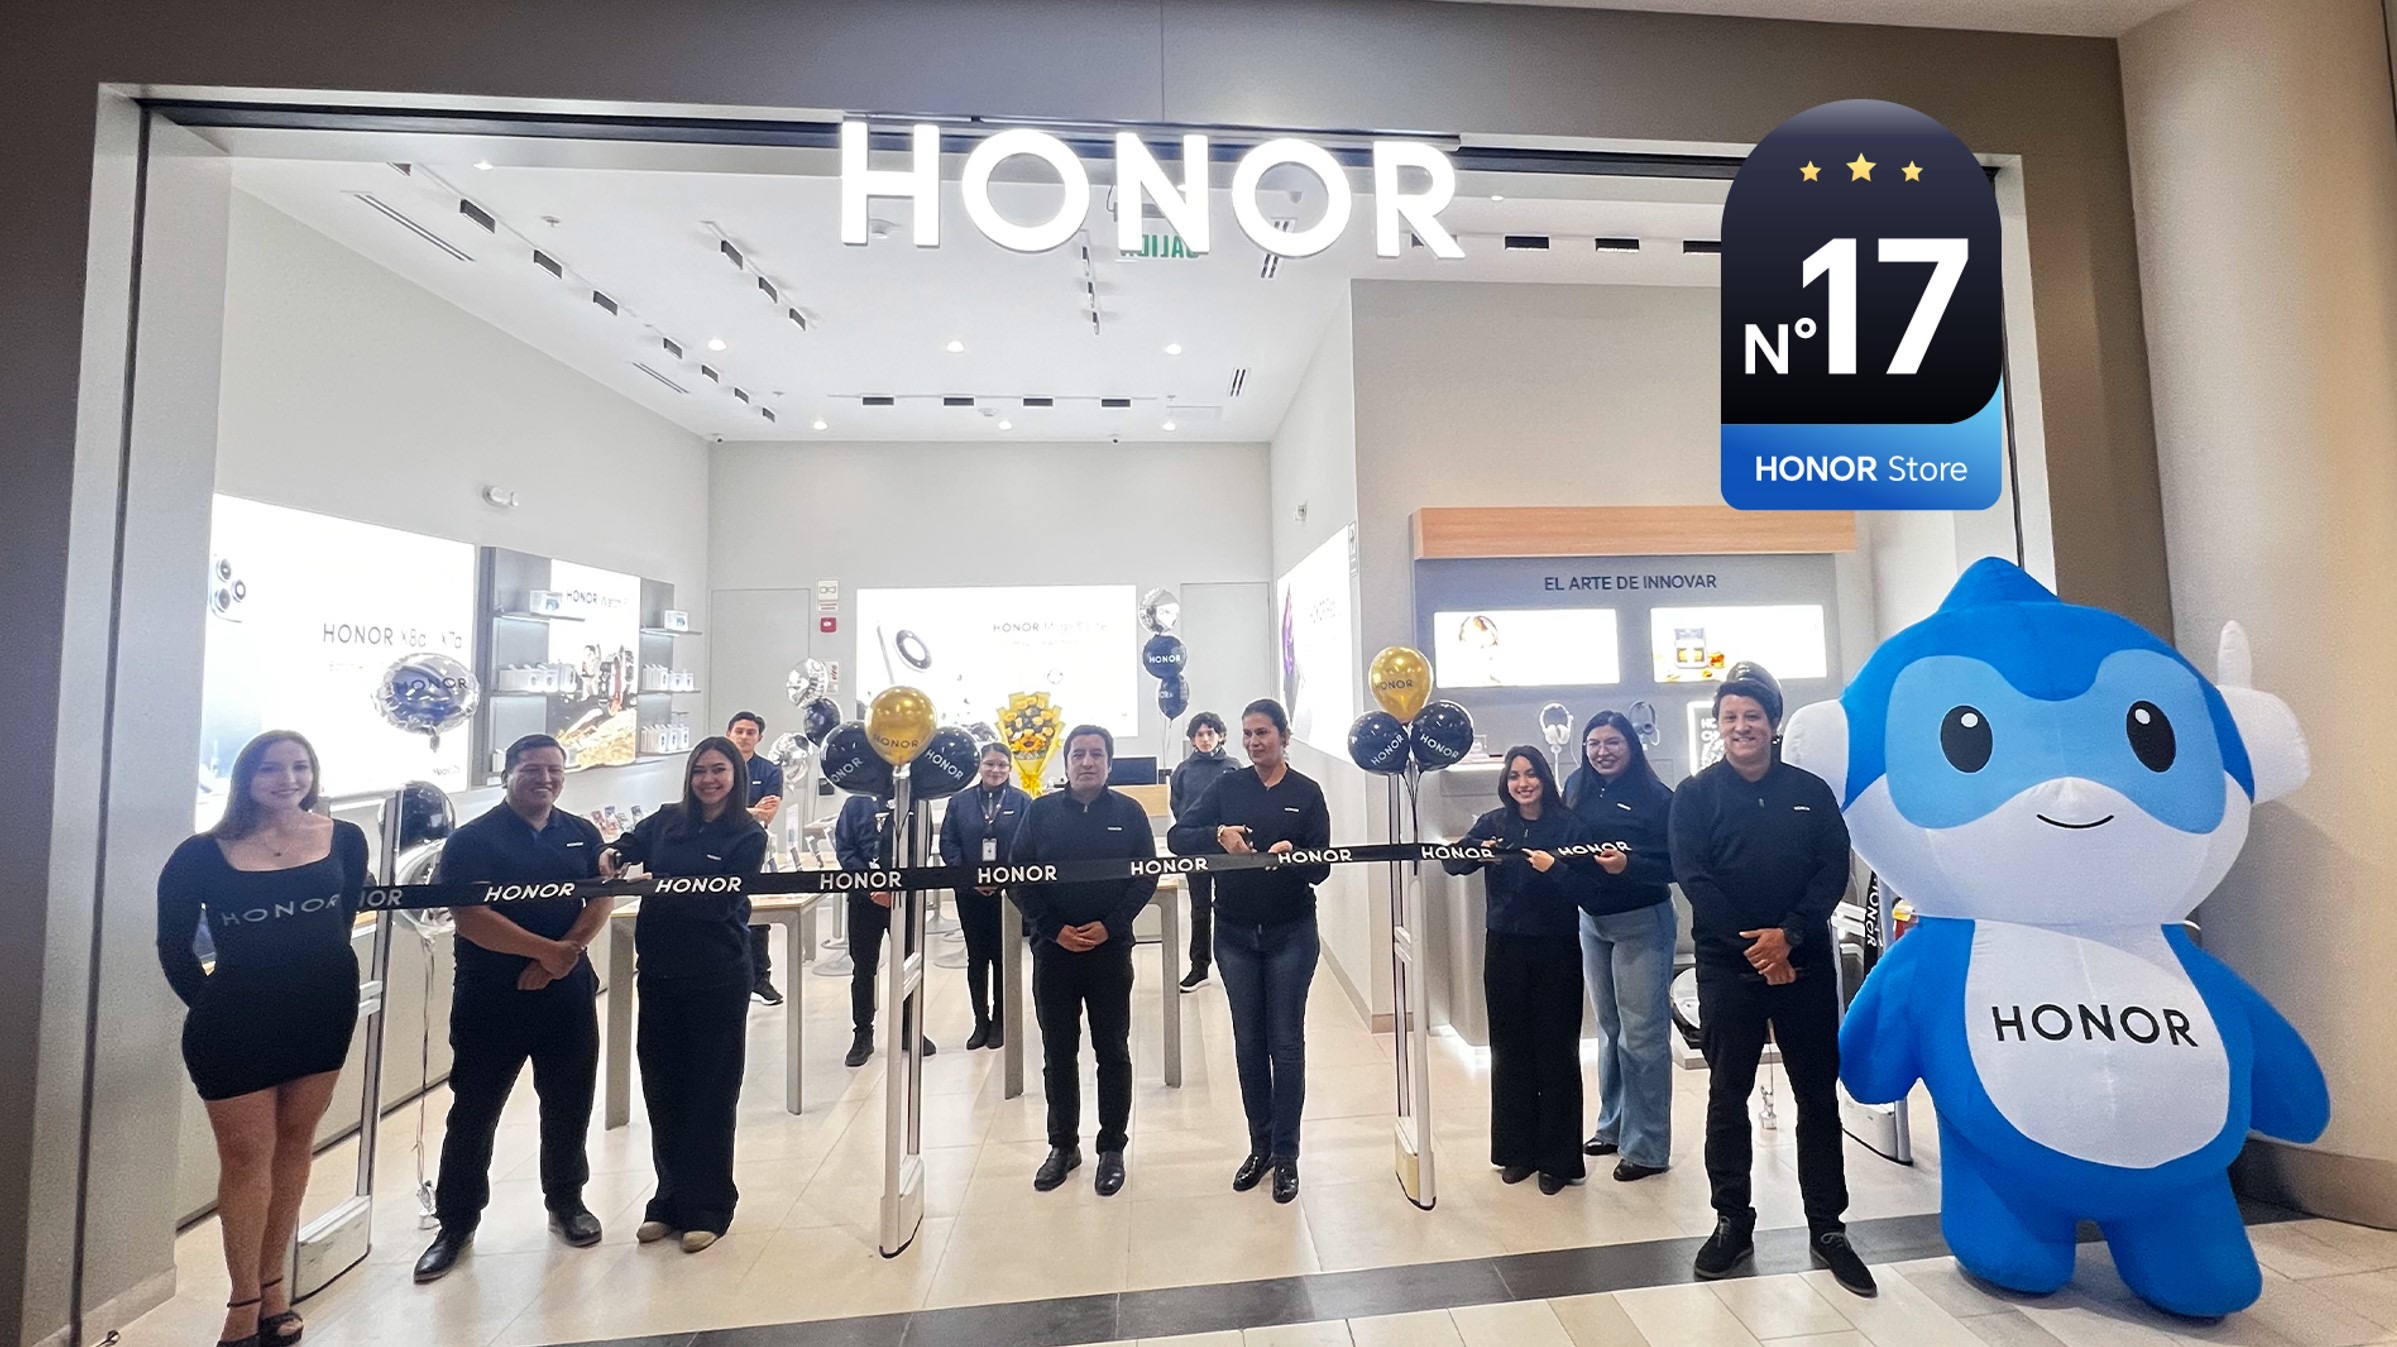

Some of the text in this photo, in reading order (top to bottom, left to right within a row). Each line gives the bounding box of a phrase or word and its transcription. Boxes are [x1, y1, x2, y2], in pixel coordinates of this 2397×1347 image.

[841, 121, 1465, 259] HONOR
[1544, 574, 1717, 591] EL ARTE DE INNOVAR
[566, 590, 598, 605] HONOR
[323, 623, 394, 646] HONOR
[993, 622, 1039, 632] HONOR
[1148, 654, 1181, 664] HONOR
[1374, 679, 1413, 691] HONOR
[873, 734, 919, 749] HONOR
[1371, 733, 1405, 766] HONOR
[1420, 733, 1459, 760] HONOR
[829, 756, 864, 784] ONOR
[924, 748, 965, 781] HONOR
[1278, 848, 1353, 865] HONOR
[1421, 846, 1495, 859] HONOR
[1557, 841, 1632, 856] HONOR
[977, 864, 1057, 884] HONOR
[1130, 857, 1208, 876] HONOR
[655, 876, 742, 894] HONOR
[819, 871, 902, 890] HONOR
[484, 882, 576, 902] HONOR
[221, 894, 341, 926] HONOR
[1991, 1003, 2199, 1047] HONOR
